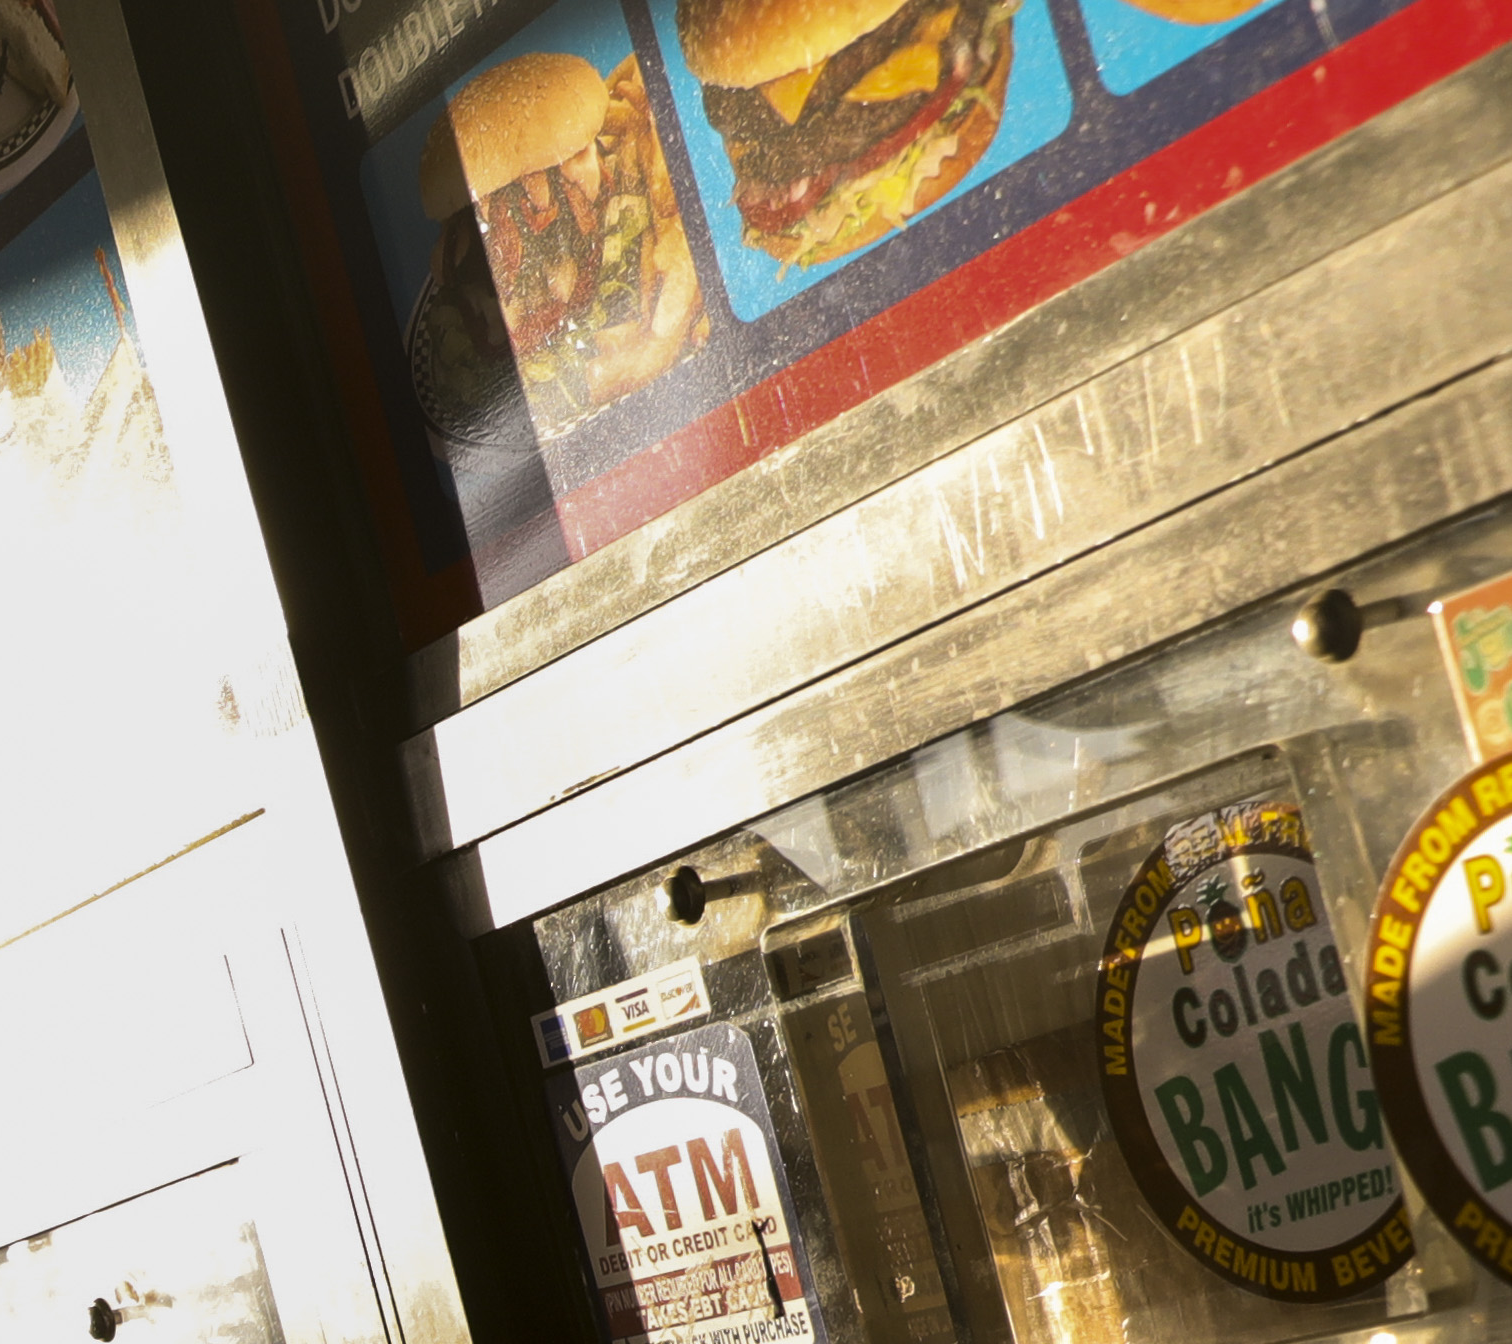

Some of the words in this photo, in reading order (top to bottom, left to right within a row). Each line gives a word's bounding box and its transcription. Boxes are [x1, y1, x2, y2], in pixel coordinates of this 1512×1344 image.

[338, 0, 465, 119] DOUBLE
[1389, 794, 1480, 915] FROM
[1116, 857, 1176, 960] FROM
[621, 1000, 650, 1021] VISA
[1104, 963, 1132, 1076] MADE
[1172, 940, 1349, 1048] Colada
[1372, 912, 1414, 1048] MADE
[563, 1067, 628, 1141] USE
[629, 1050, 738, 1102] YOUR
[1154, 1021, 1386, 1199] BANG
[603, 1127, 760, 1247] ATM
[1247, 1203, 1282, 1235] it's
[1284, 1165, 1394, 1222] WHIPPED!
[599, 1247, 643, 1277] DEBIT
[646, 1242, 671, 1264] OR
[672, 1226, 729, 1257] CREDIT
[732, 1215, 778, 1243] CARD
[702, 1268, 717, 1292] FOR
[717, 1263, 733, 1287] ALL
[1176, 1205, 1318, 1293] PREMIUM
[637, 1299, 688, 1330] TAKES
[688, 1293, 723, 1321] EBT
